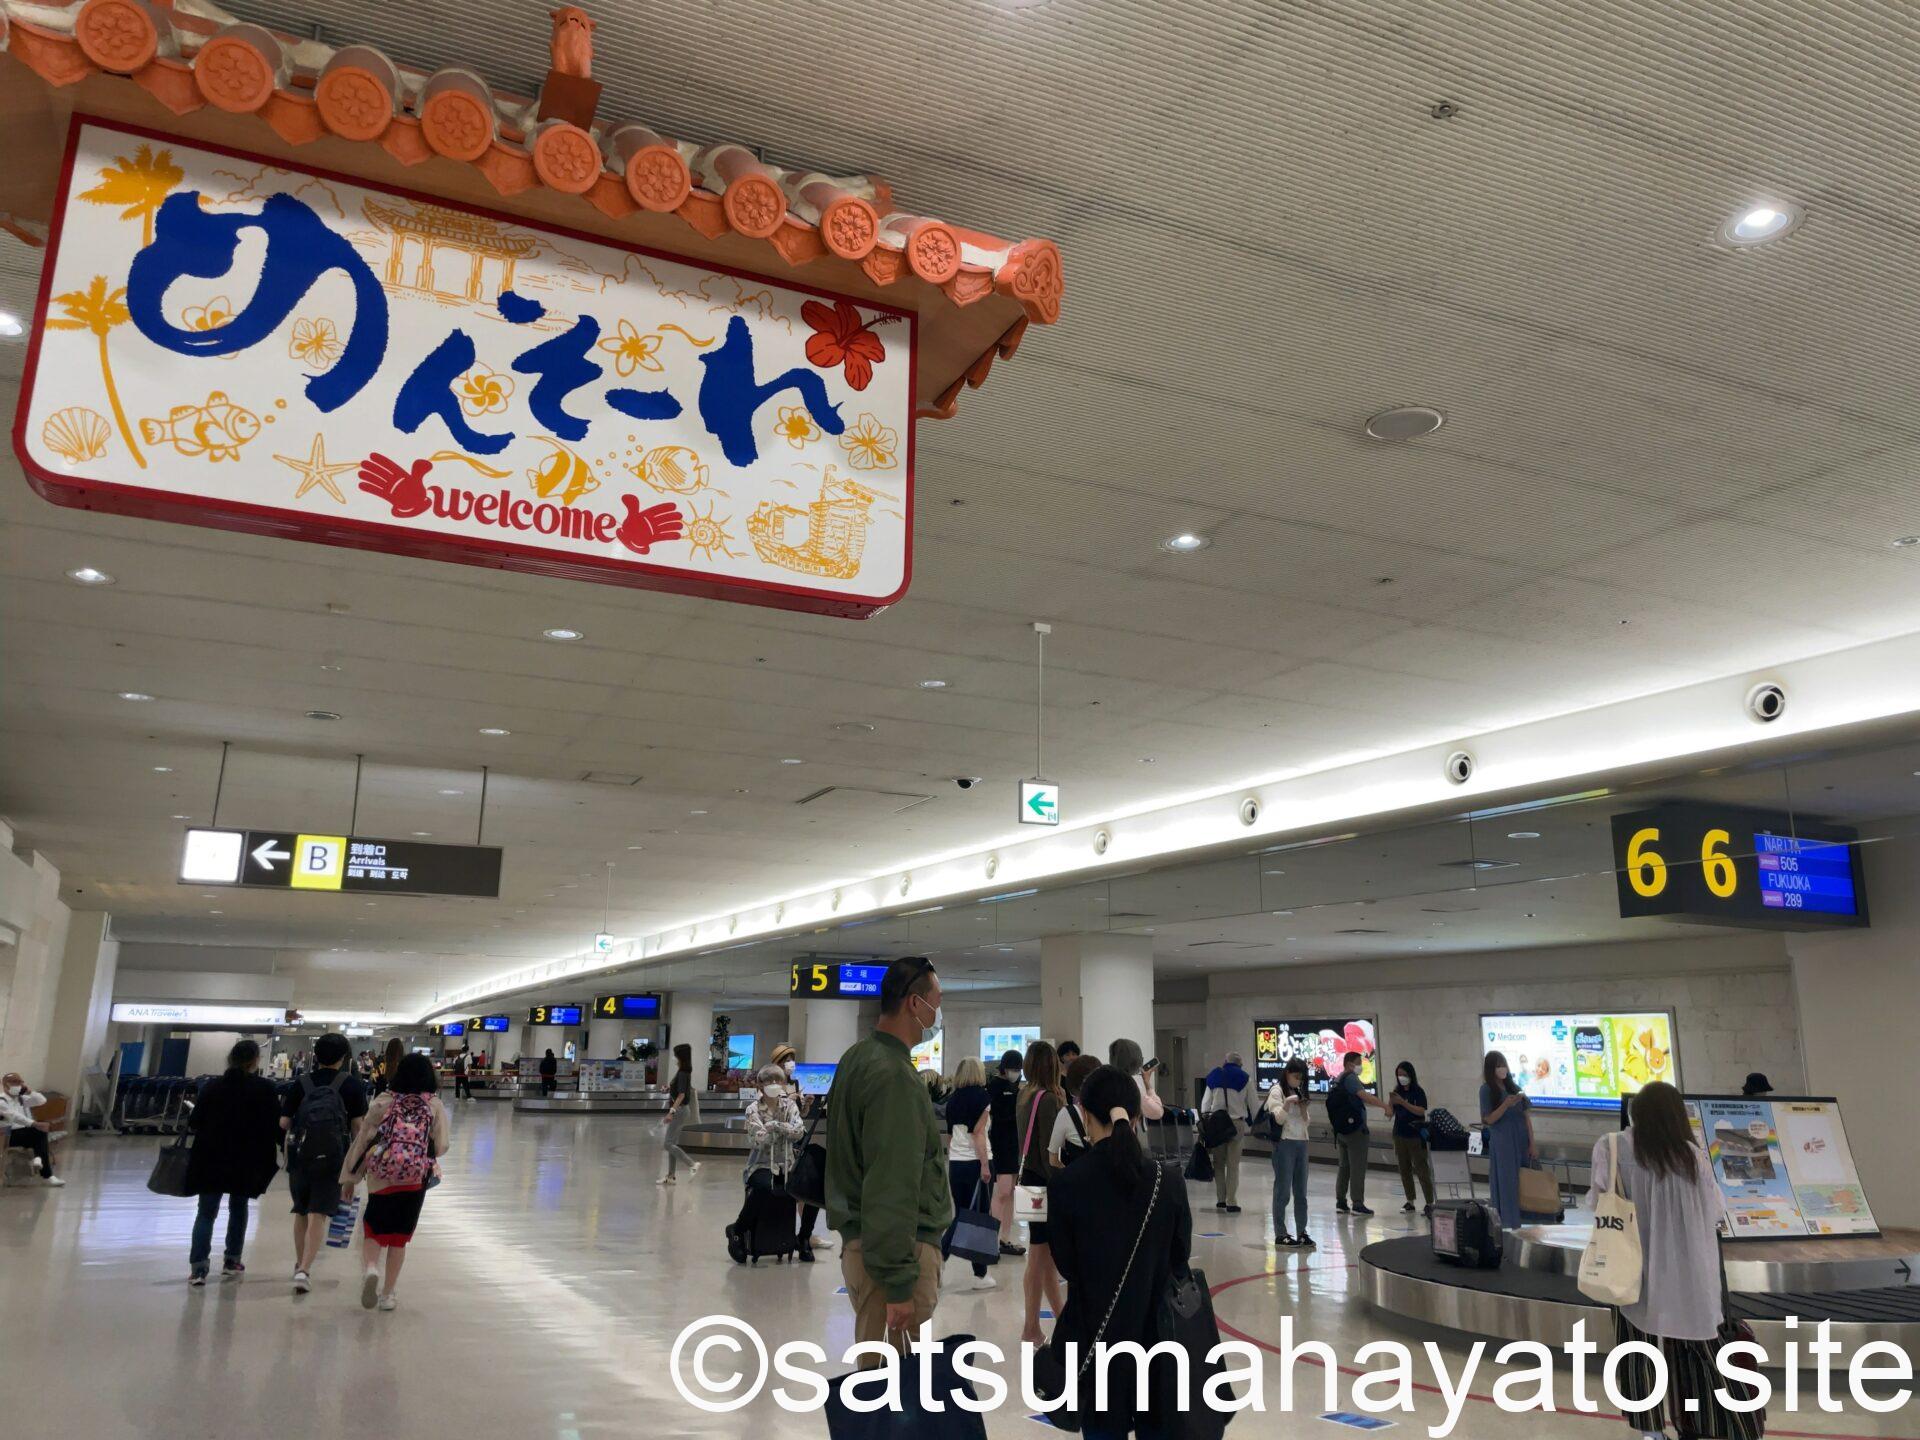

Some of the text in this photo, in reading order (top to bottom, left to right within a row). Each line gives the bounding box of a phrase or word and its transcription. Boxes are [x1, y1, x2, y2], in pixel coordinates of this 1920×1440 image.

[127, 191, 845, 467] めんそーれ
[427, 486, 617, 543] welcome
[309, 845, 328, 871] B
[350, 843, 386, 856] 到着口
[349, 855, 386, 866] Arrivals
[1627, 827, 1668, 898] 6
[1701, 828, 1737, 898] 6
[1780, 856, 1799, 872] 505
[1768, 872, 1811, 891] FUKUOKA
[1784, 893, 1803, 908] 289
[811, 964, 828, 992] 5
[603, 996, 616, 1014] 4
[472, 1018, 481, 1030] 2
[535, 1008, 546, 1022] 3
